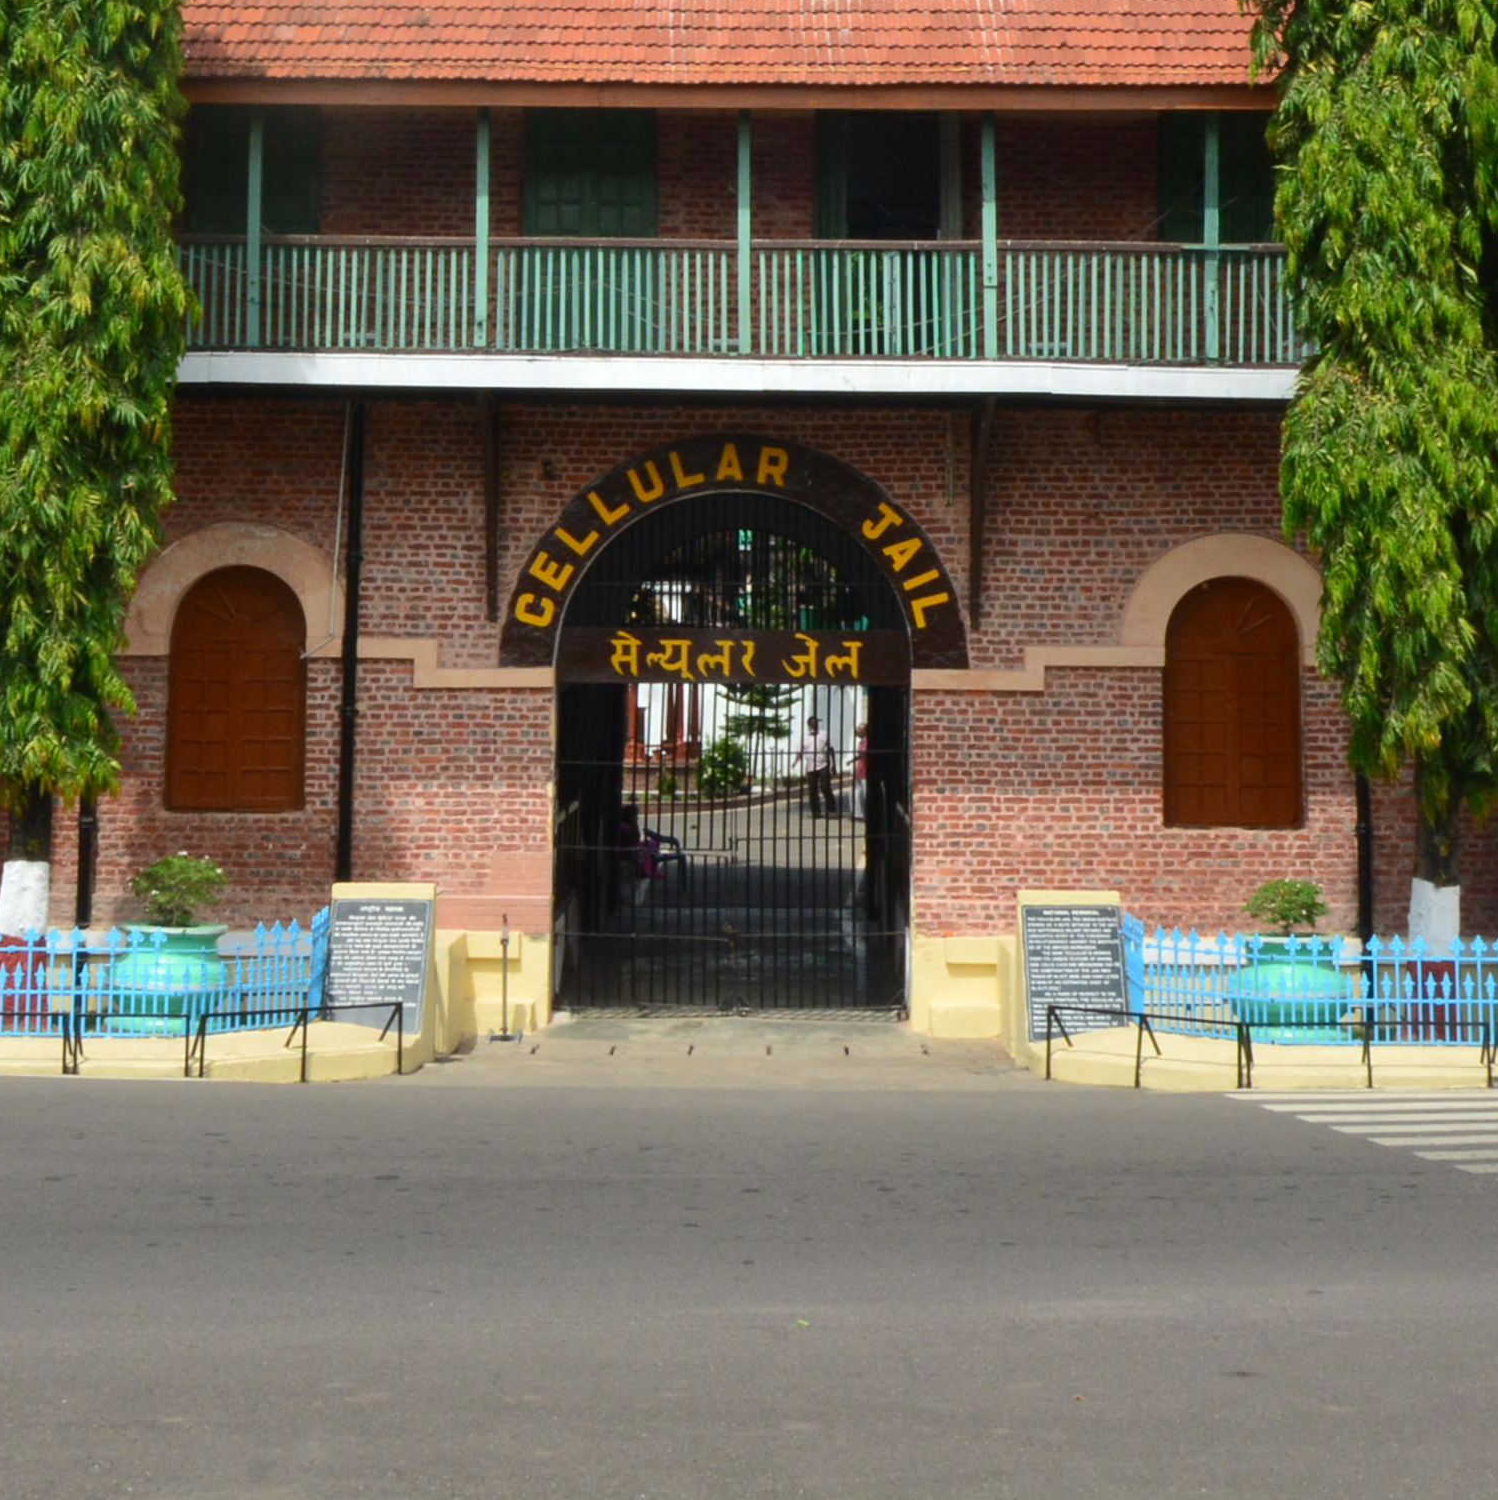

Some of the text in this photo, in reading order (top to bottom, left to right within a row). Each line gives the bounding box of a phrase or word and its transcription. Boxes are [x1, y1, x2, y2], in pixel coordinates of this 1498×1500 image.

[515, 443, 949, 629] CELLULAR JAIL
[610, 631, 863, 681] सेल्यूलर जेल
